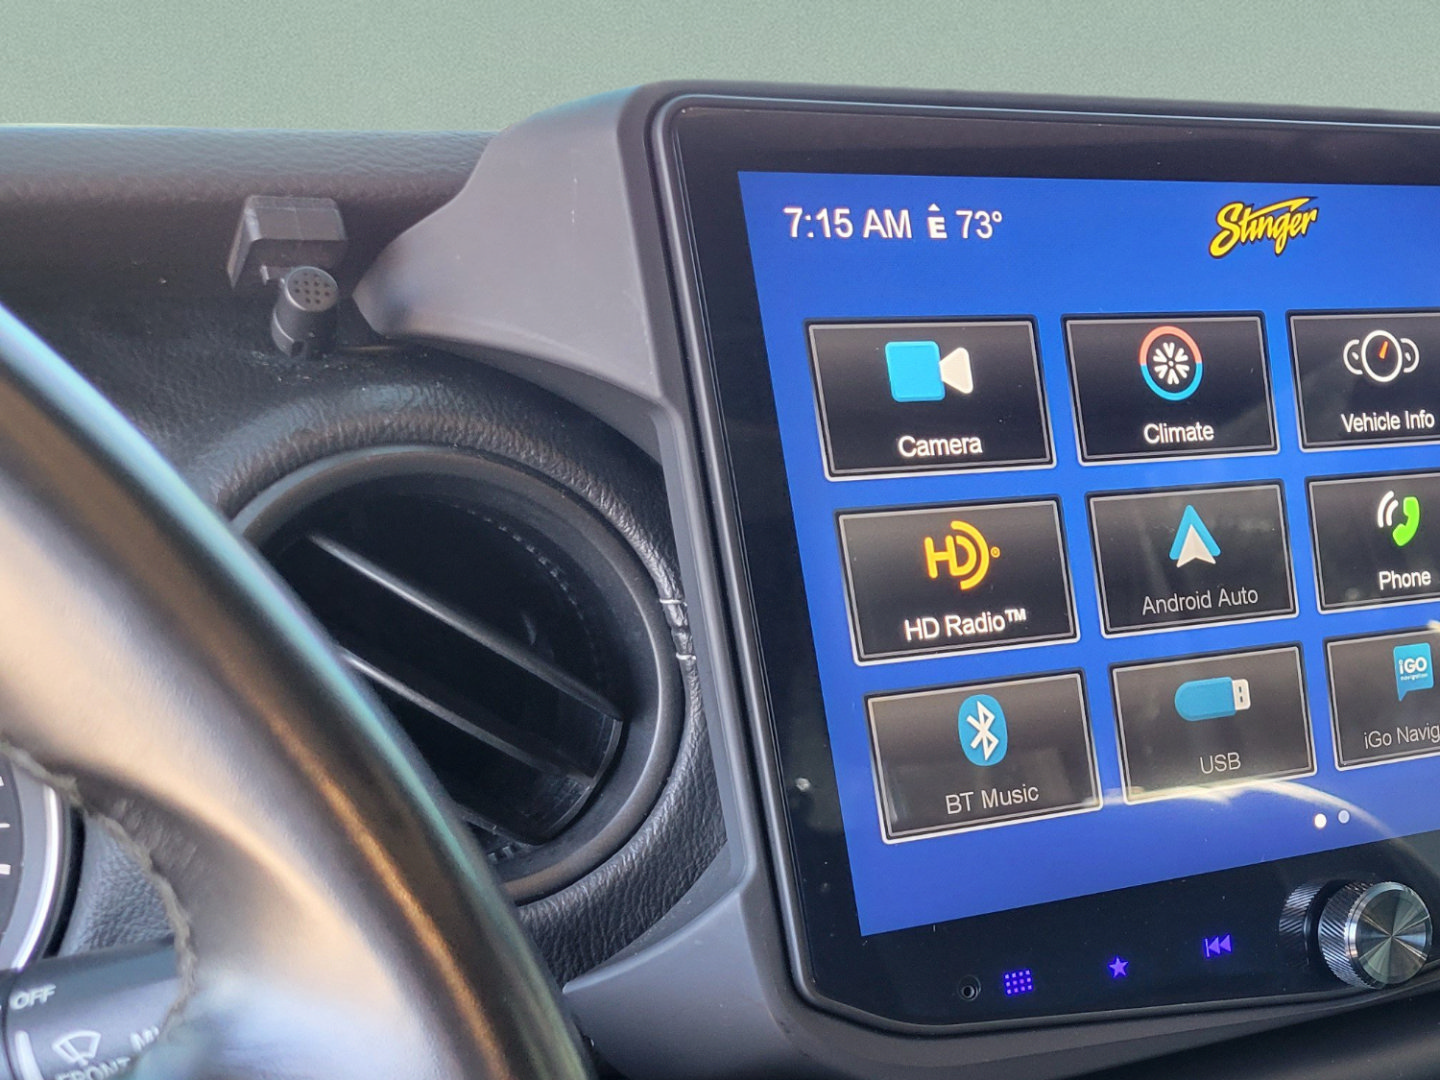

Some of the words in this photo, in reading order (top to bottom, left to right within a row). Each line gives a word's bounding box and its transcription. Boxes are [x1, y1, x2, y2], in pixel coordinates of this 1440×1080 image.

[784, 208, 853, 239] 7:15
[863, 208, 912, 239] AM
[956, 210, 1003, 239] 73°
[1208, 196, 1318, 258] Stinger
[1143, 421, 1215, 446] Climate
[1341, 411, 1400, 434] Vehicle
[1404, 409, 1435, 430] Info
[898, 435, 983, 459] Camera
[1378, 567, 1432, 591] Phone
[1142, 592, 1212, 616] Android
[1217, 587, 1259, 607] Auto
[904, 616, 940, 642] HD
[1364, 728, 1393, 750] iGo
[1199, 752, 1242, 775] USB
[945, 791, 974, 816] BT
[981, 784, 1040, 809] Music
[9, 983, 57, 1011] OFF
